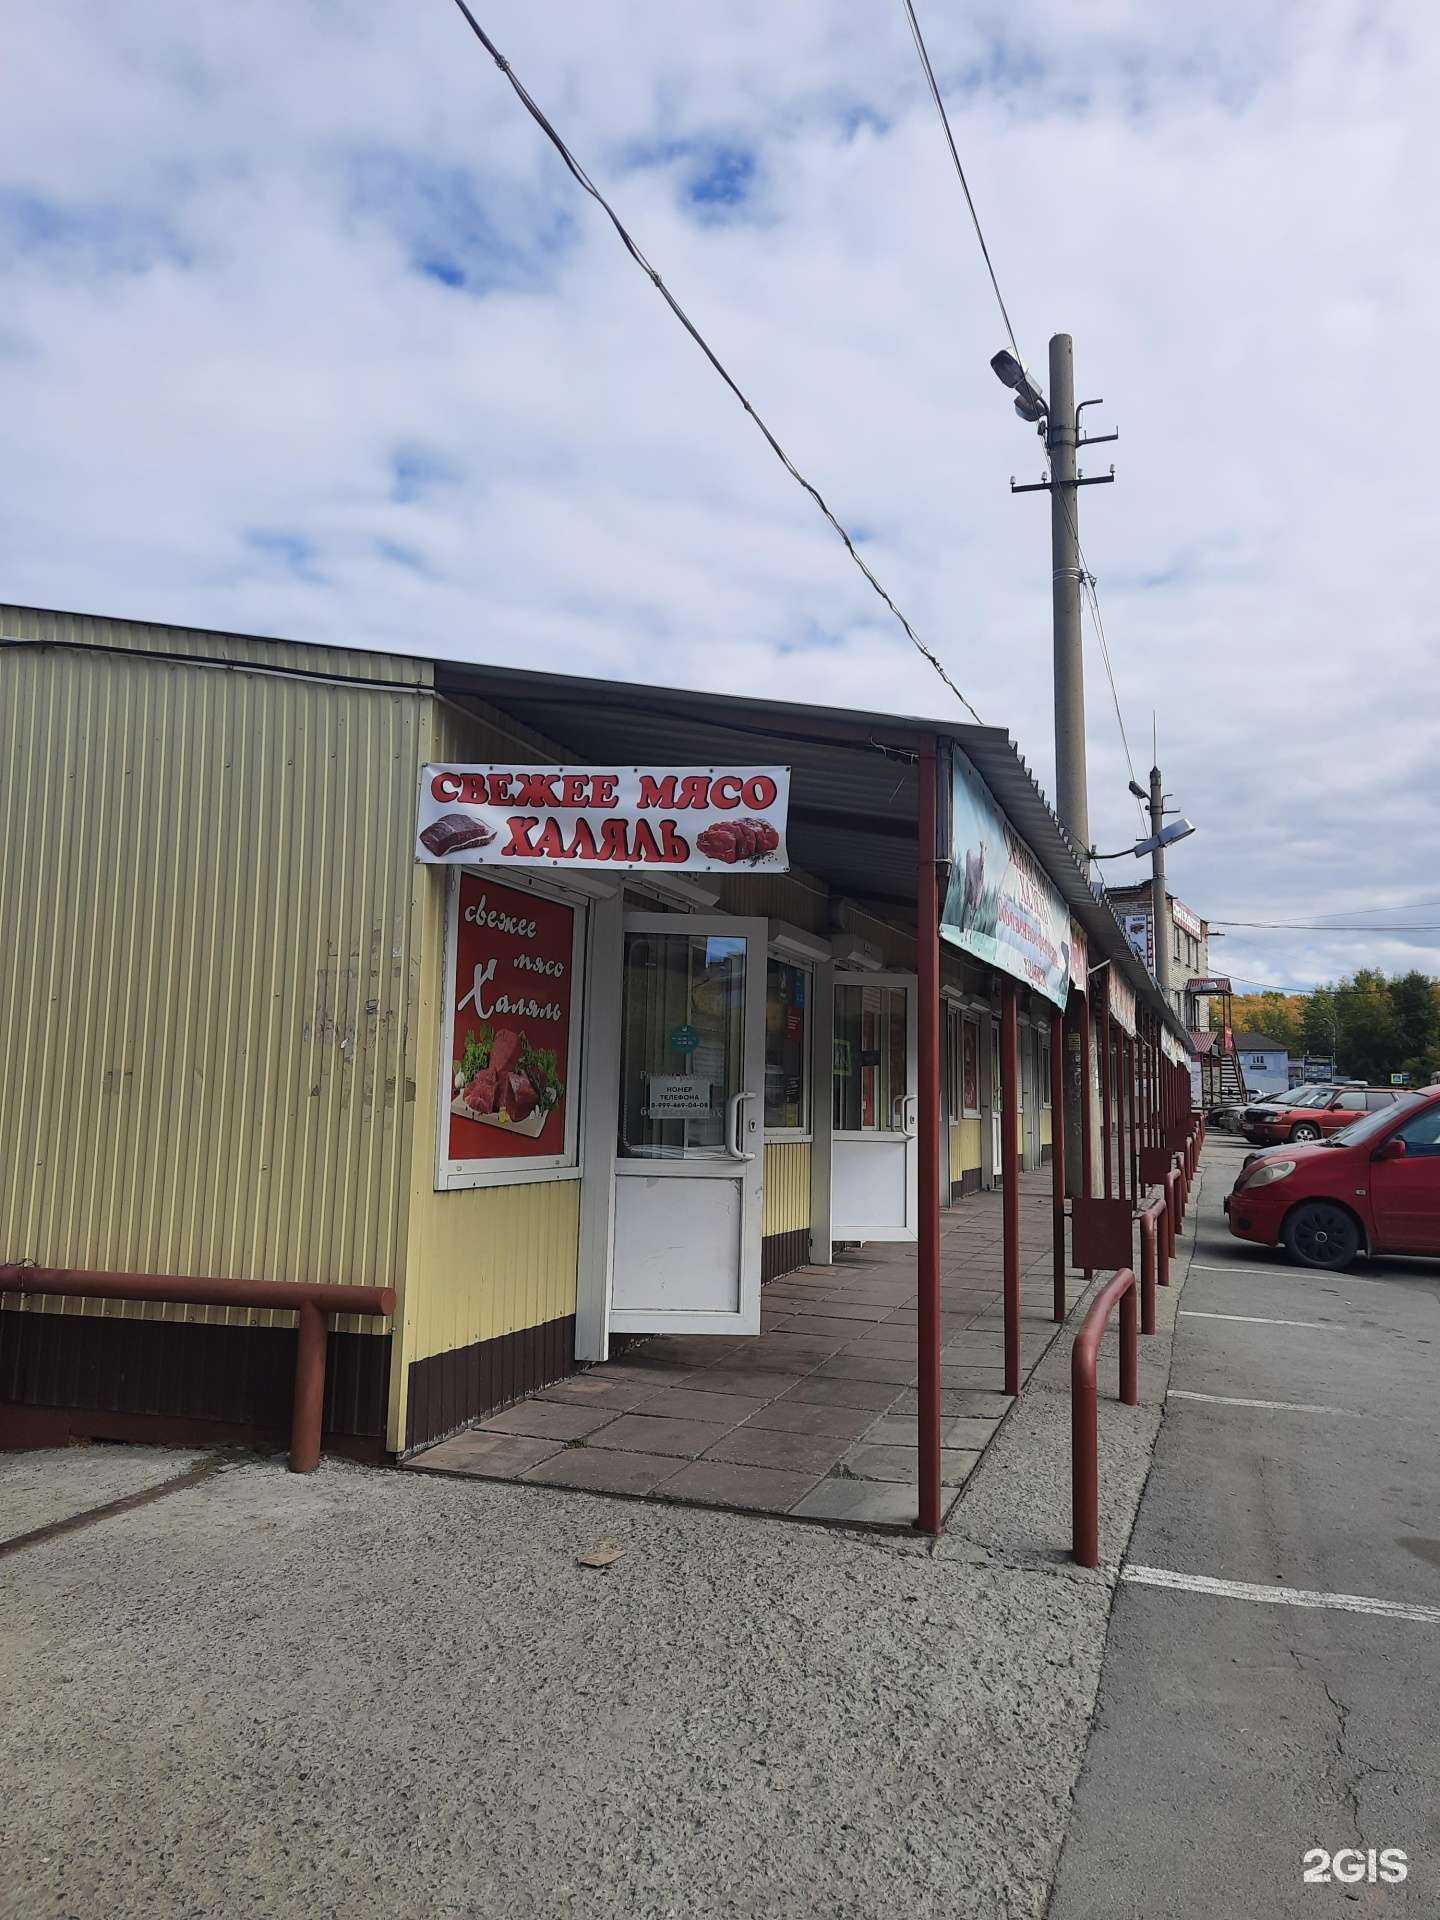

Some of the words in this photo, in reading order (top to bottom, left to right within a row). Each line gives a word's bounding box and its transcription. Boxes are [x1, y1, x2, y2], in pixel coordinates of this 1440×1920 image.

[431, 772, 619, 809] СВЕЖЕЕ
[636, 775, 778, 811] МЯСО
[501, 815, 691, 864] ХАЛЯЛЬ
[464, 894, 537, 938] свежее
[513, 952, 564, 978] мясо
[457, 958, 562, 1020] Халяль
